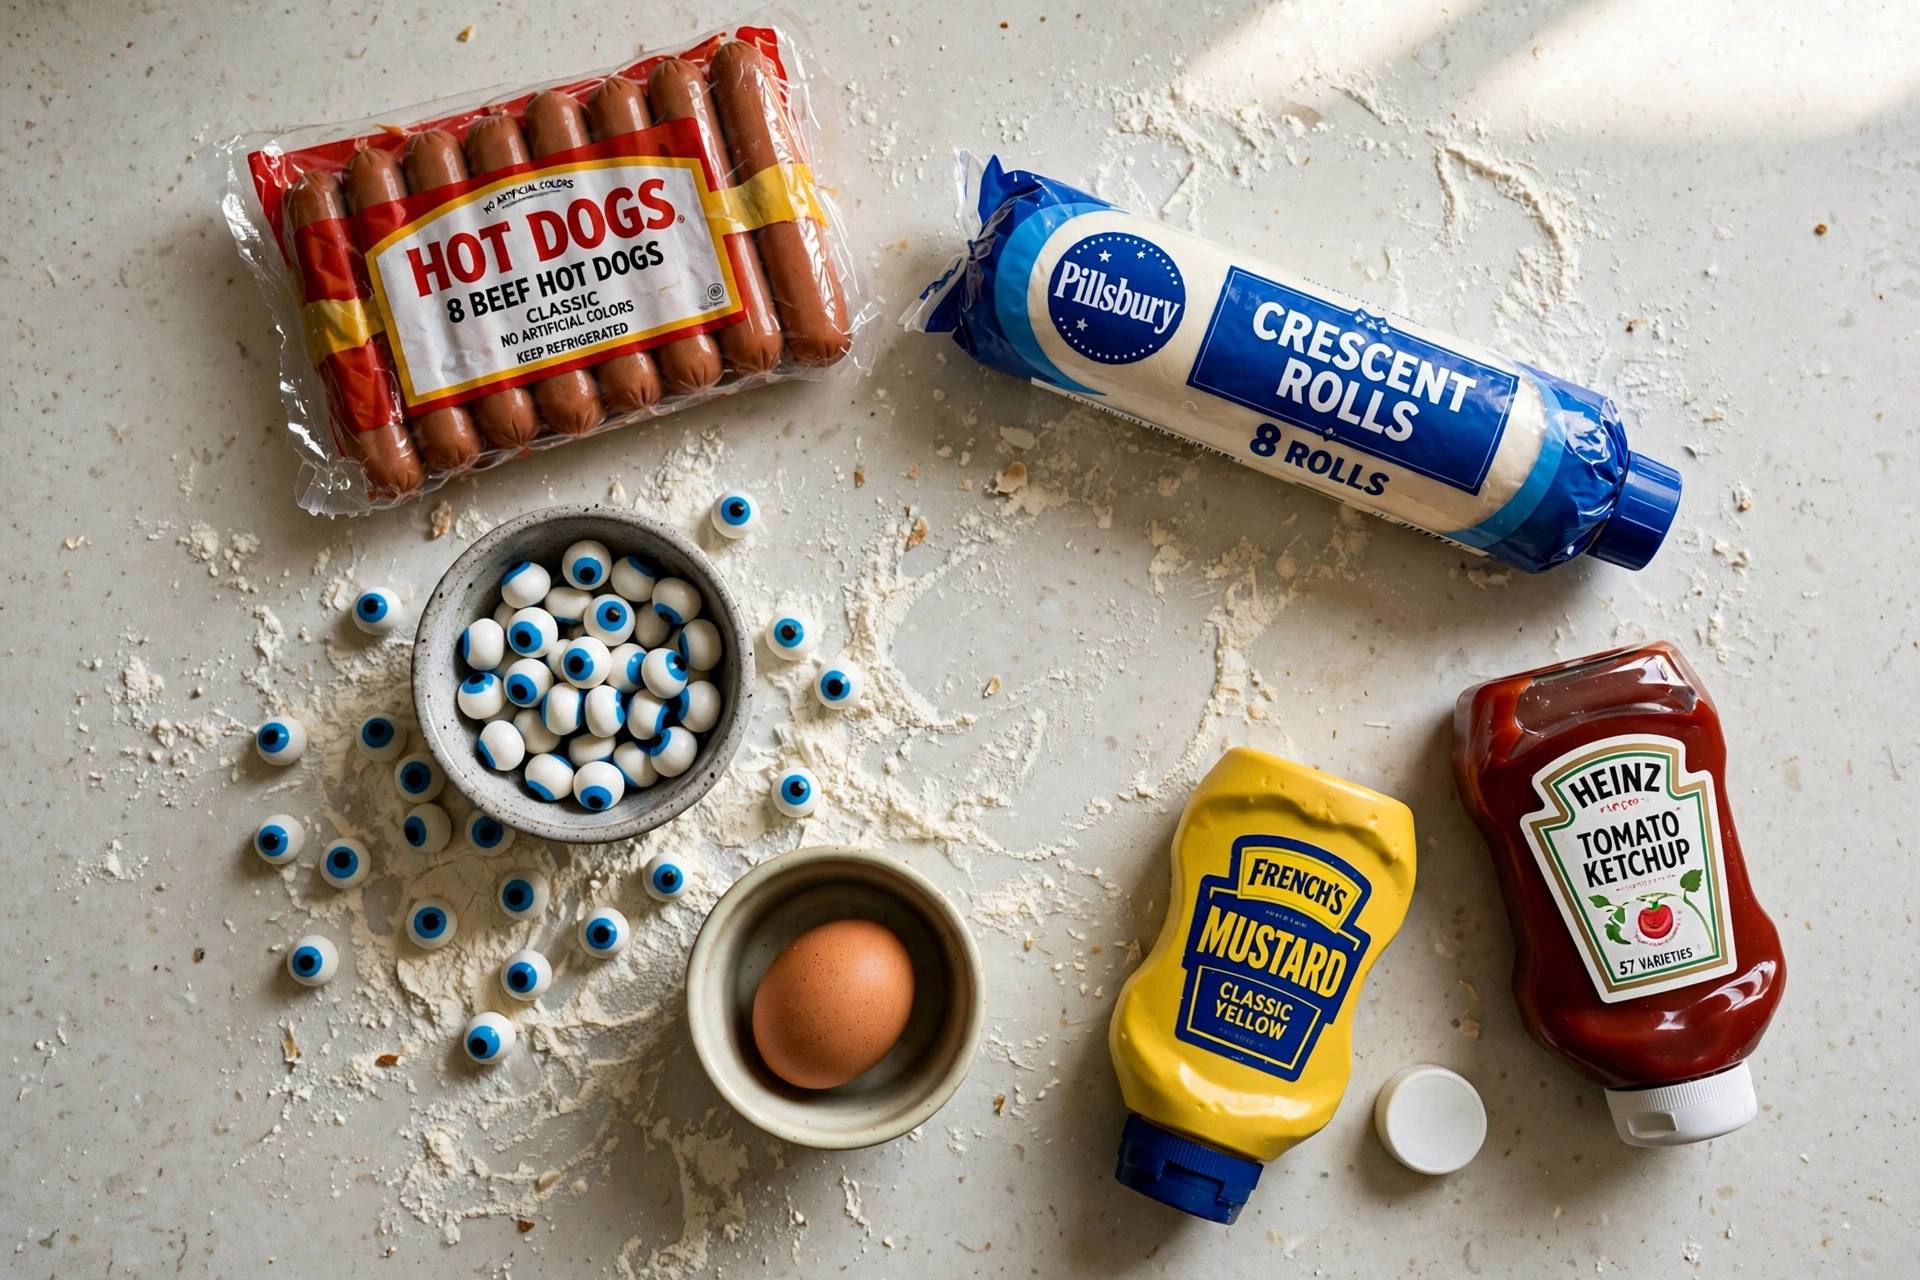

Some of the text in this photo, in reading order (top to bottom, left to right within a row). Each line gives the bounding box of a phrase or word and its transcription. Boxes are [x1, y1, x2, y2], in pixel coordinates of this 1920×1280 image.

[406, 178, 676, 297] HOT DOGS
[447, 240, 665, 324] 8 BEEF HOT DOGS
[526, 291, 600, 324] CLASSIC
[1053, 260, 1182, 335] Pillsbury
[500, 299, 634, 348] NO ARTIFICIAL COLORS
[516, 322, 629, 365] KEEP REFRIGERATED
[1252, 300, 1478, 413] CRESCENT
[1276, 356, 1420, 442] ROLLS
[1249, 422, 1281, 458] 8
[1283, 440, 1391, 497] ROLLS
[1568, 762, 1662, 809] HEINZ
[1577, 811, 1680, 859] TOMATO
[1247, 858, 1349, 916] FRENCH'S
[1583, 838, 1690, 889] KETCHUP
[1196, 904, 1348, 999] MUSTARD
[1619, 947, 1693, 976] 57 VARIETIES
[1215, 999, 1288, 1041] YELLOW
[1219, 981, 1294, 1022] CLASSIC
